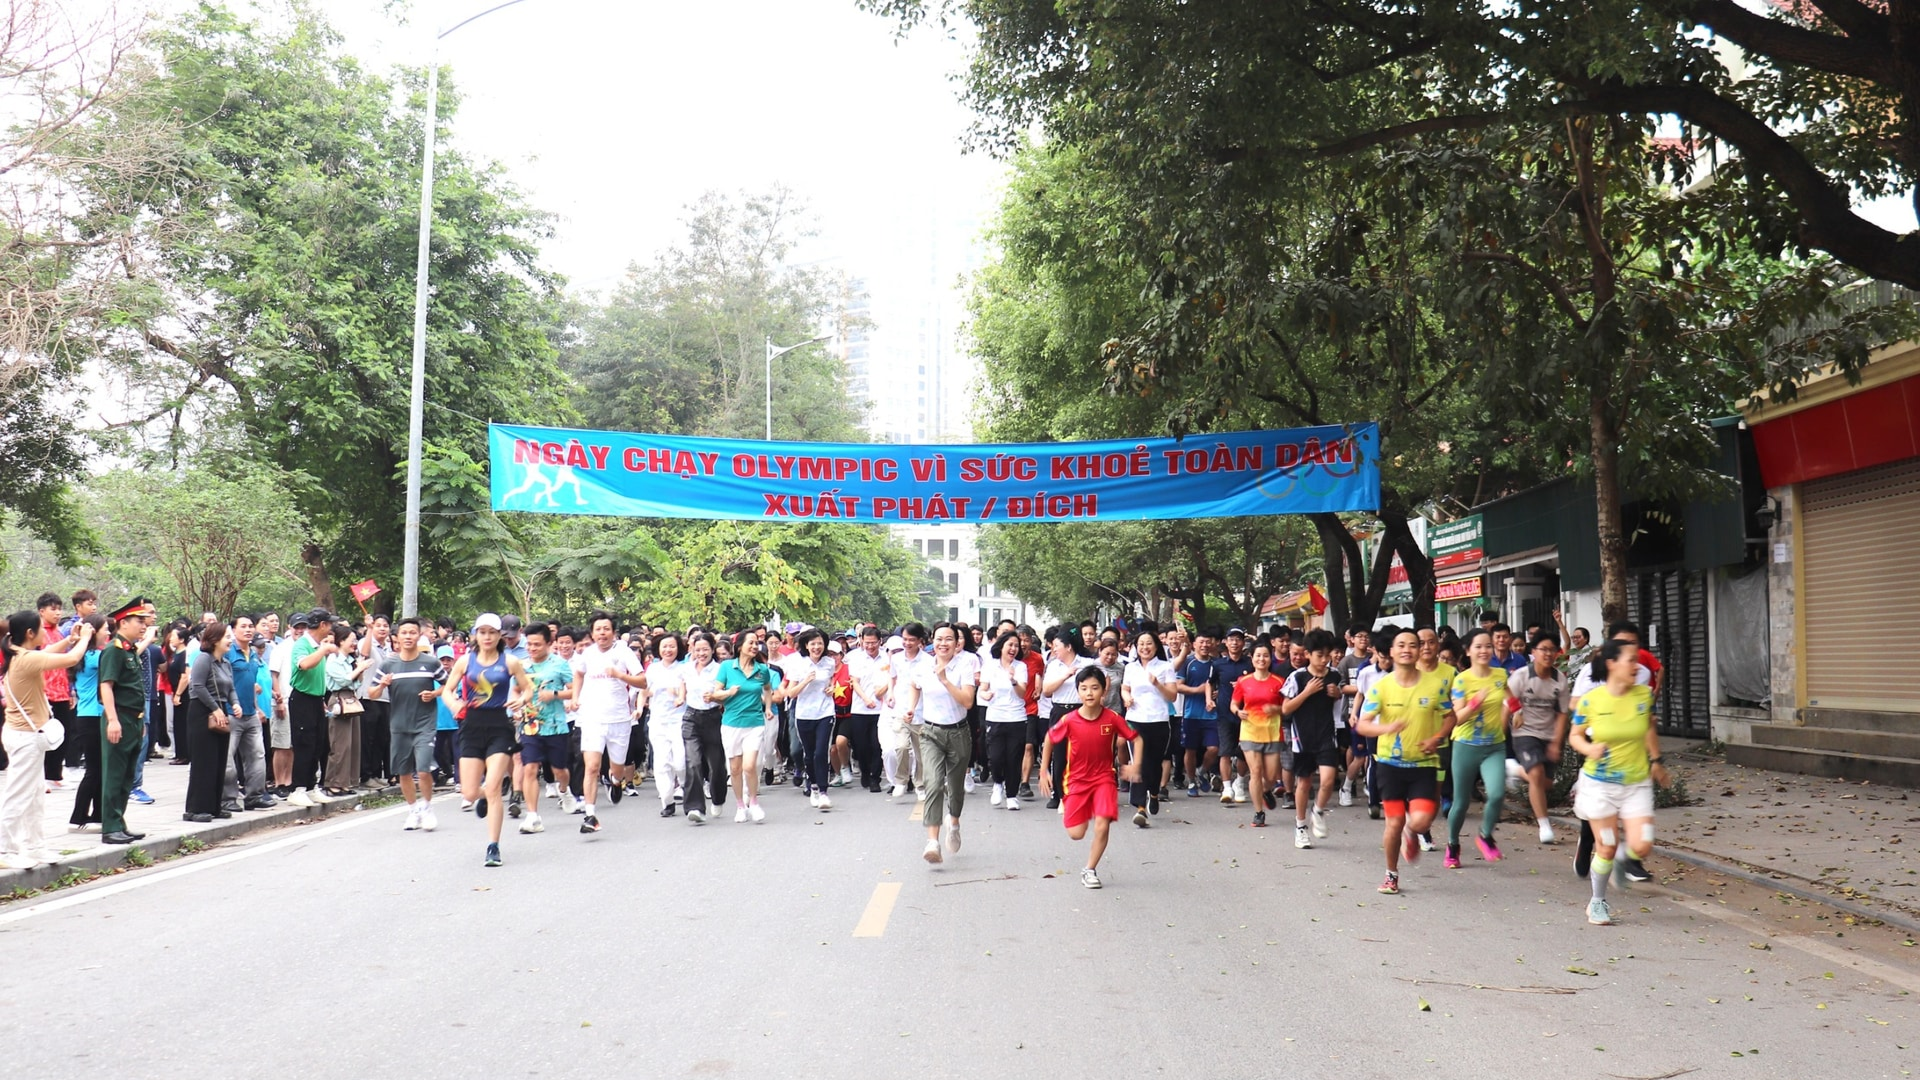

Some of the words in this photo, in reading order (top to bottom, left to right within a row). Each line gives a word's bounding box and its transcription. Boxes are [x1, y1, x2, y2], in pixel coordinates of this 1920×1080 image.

[514, 439, 611, 470] NGÀY
[623, 447, 720, 479] CHẠY
[733, 454, 898, 482] OLYMPIC
[911, 454, 947, 483] VÌ
[960, 453, 1037, 482] SỨC
[1051, 444, 1151, 480] KHOẺ
[1163, 442, 1263, 475] TOÀN
[1275, 437, 1354, 468] DÂN
[764, 488, 861, 519] XUẤT
[873, 492, 971, 520] PHÁT
[981, 496, 998, 519] /
[1006, 492, 1098, 518] ĐÍCH
